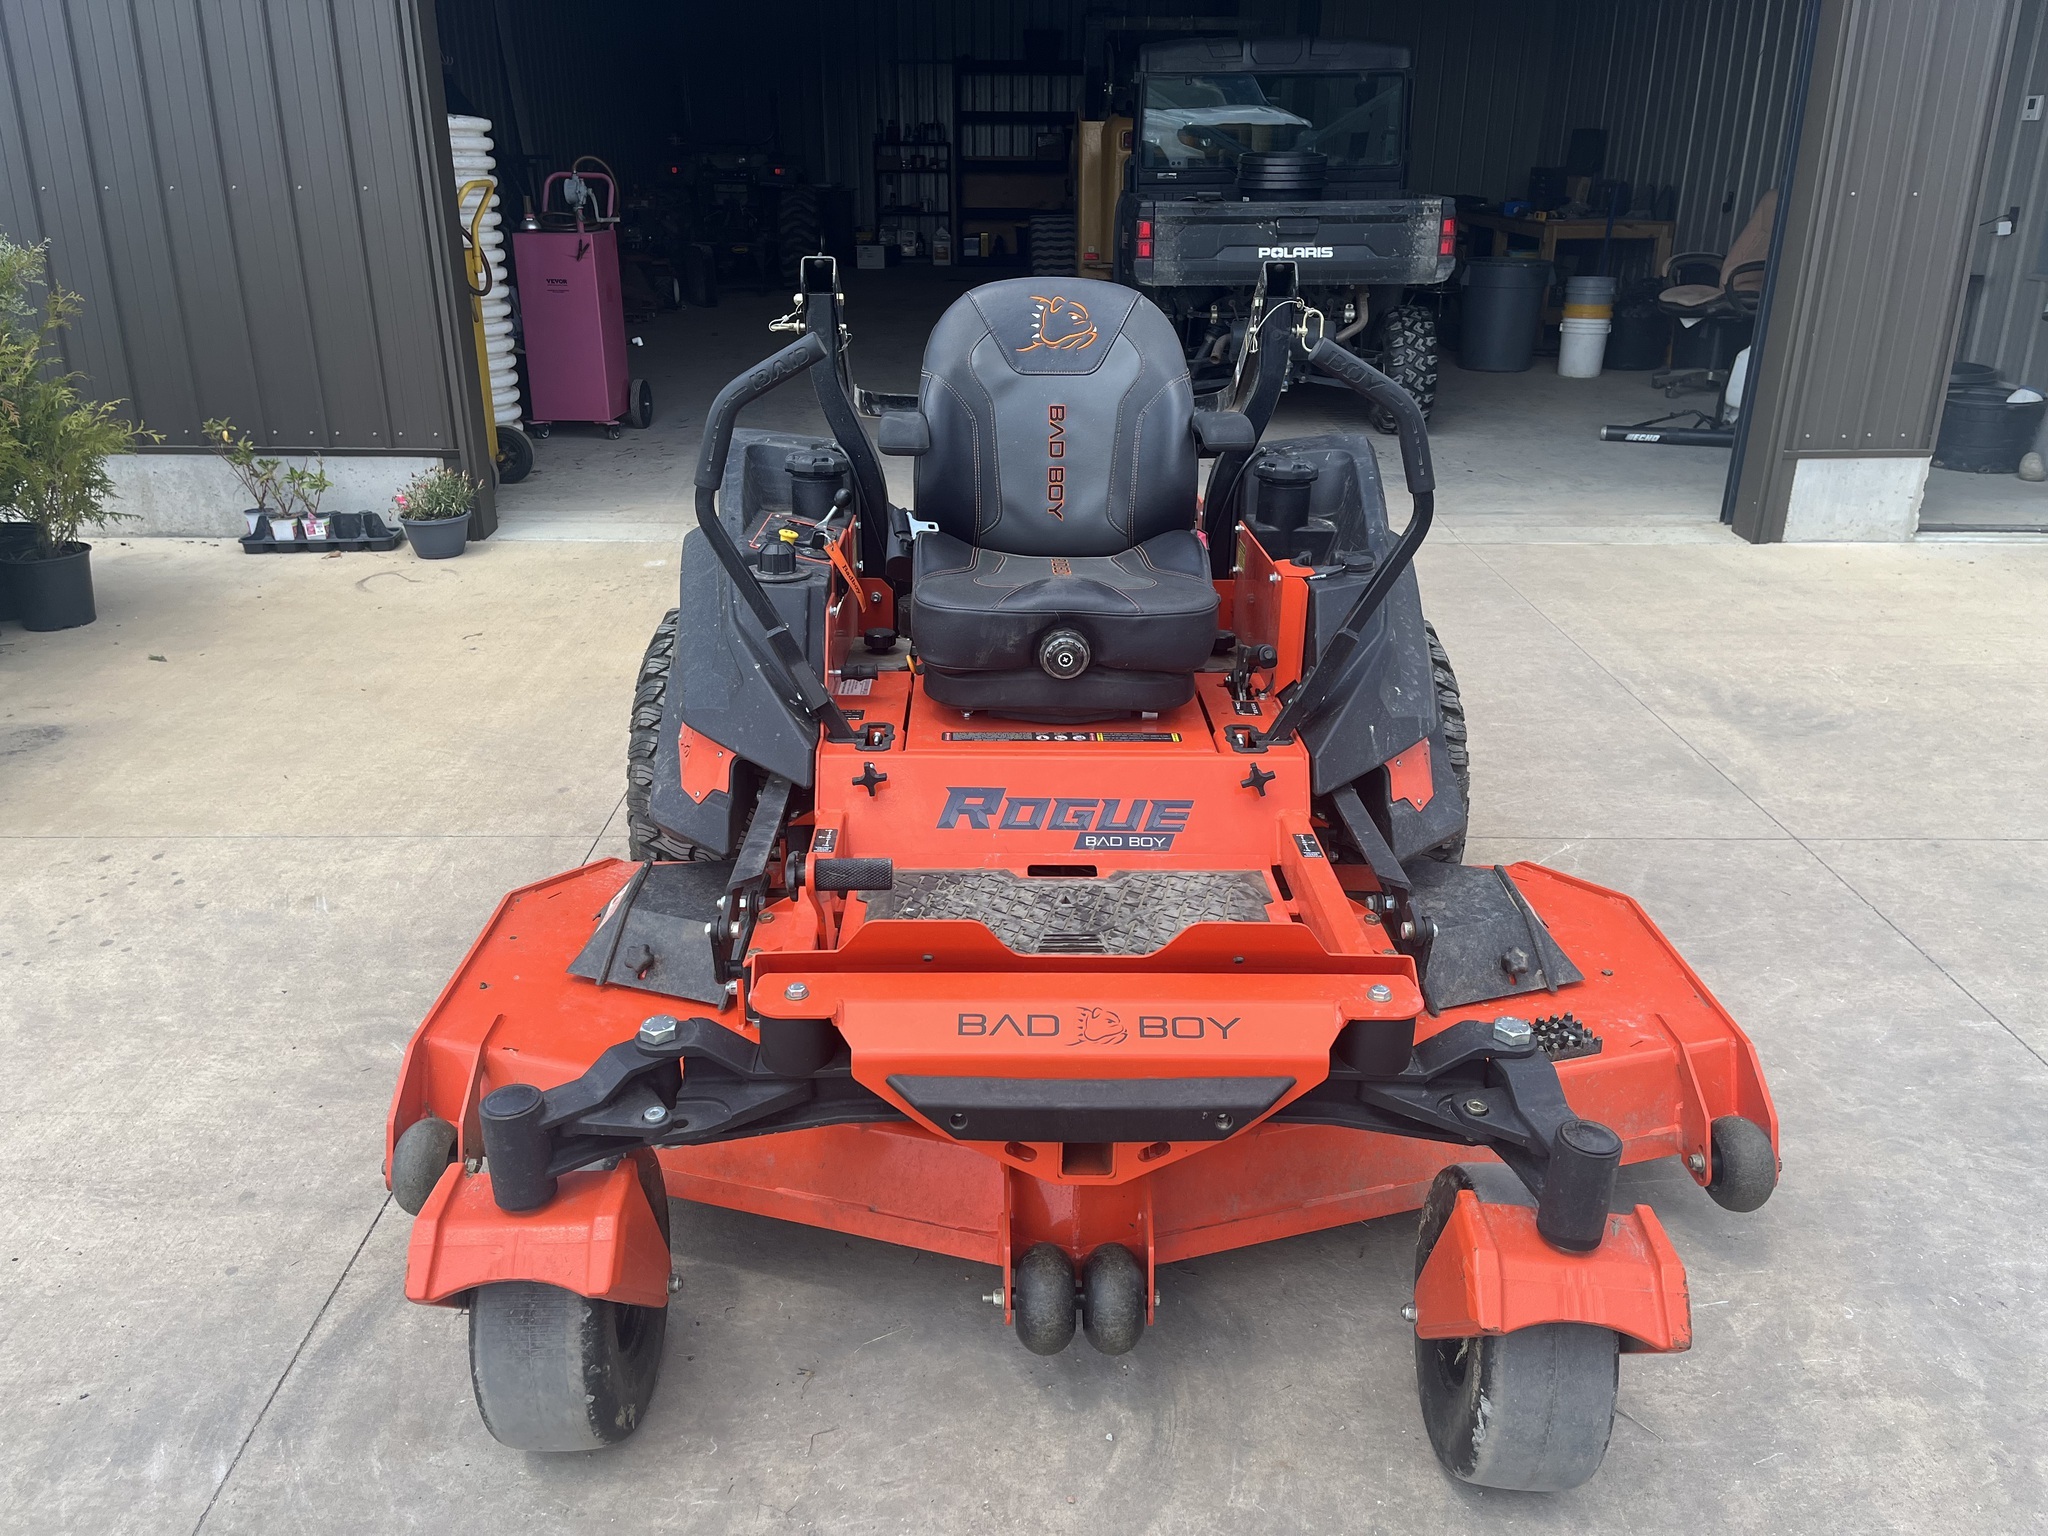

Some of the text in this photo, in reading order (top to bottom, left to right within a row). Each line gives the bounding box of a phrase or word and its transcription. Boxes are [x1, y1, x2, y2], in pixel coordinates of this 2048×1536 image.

[1258, 246, 1334, 259] POLARIS
[1325, 350, 1387, 391] BOY
[1630, 433, 1661, 442] ECHO
[1047, 404, 1066, 521] BAD BOY
[842, 564, 862, 594] Badboy
[1085, 836, 1167, 848] BAD BOY
[957, 1013, 1242, 1040] BAD BOY
